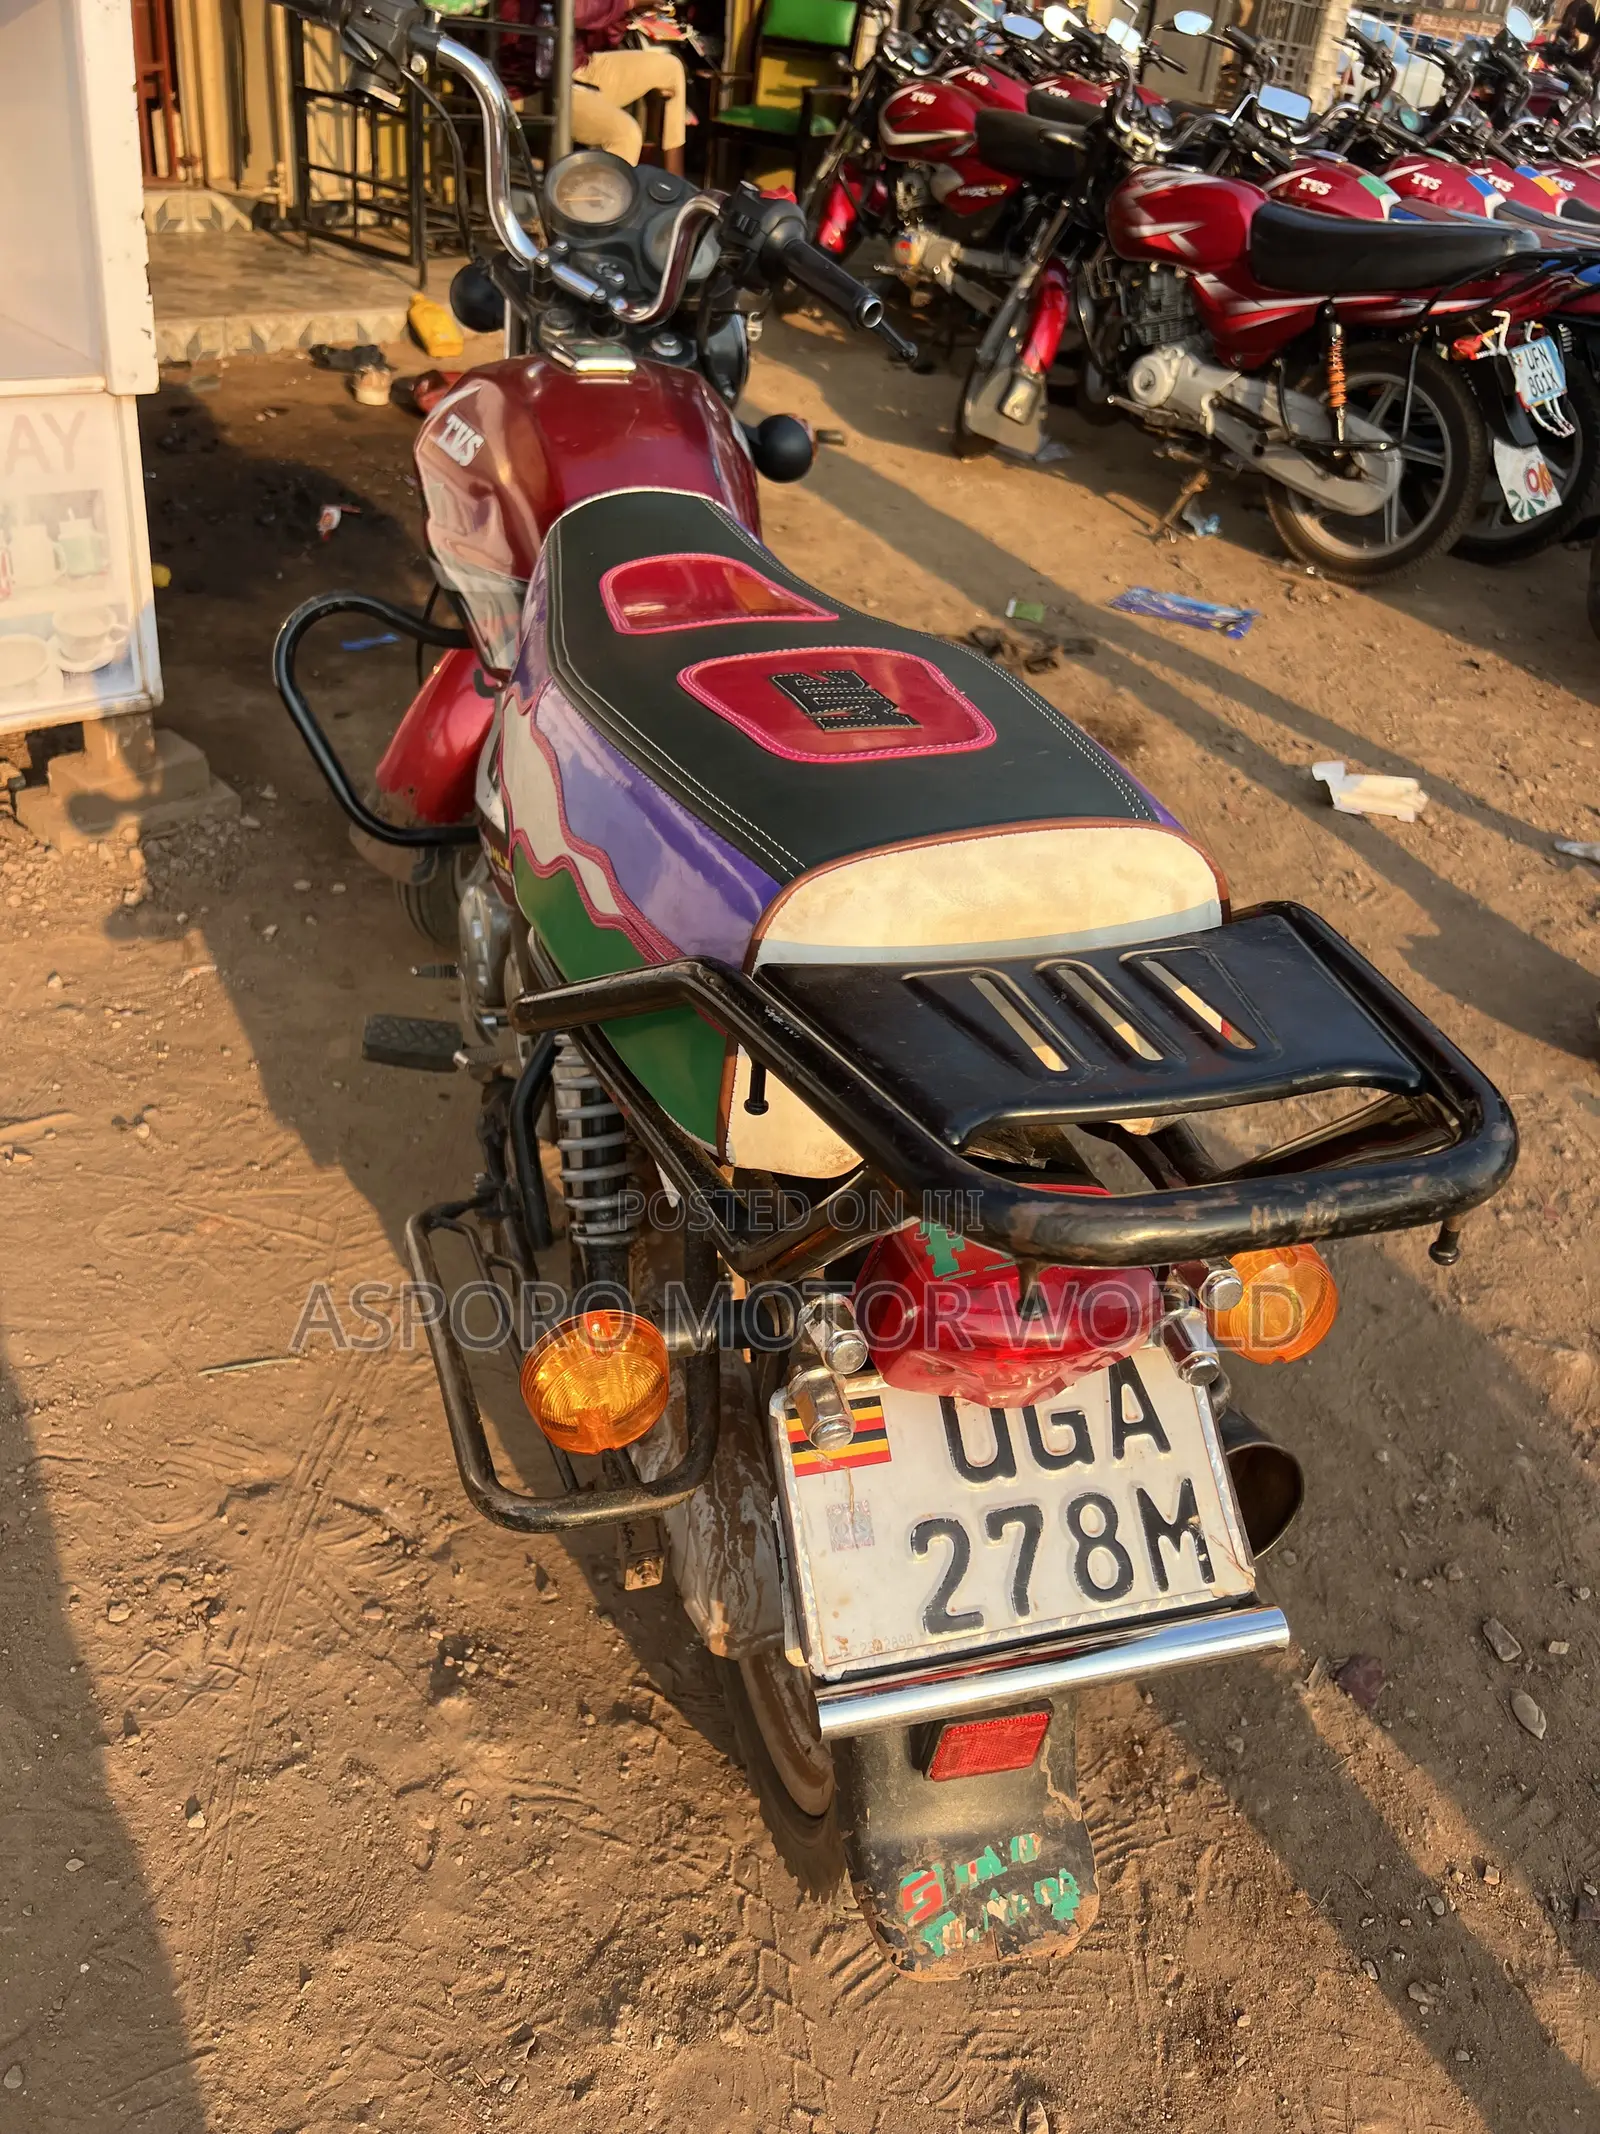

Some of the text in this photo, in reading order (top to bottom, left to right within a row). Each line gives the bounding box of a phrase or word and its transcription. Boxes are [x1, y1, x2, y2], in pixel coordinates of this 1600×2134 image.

[1524, 343, 1550, 371] UFN
[1527, 368, 1560, 398] 801X
[436, 413, 485, 467] TVS
[938, 1356, 1172, 1485] UGA
[909, 1477, 1216, 1635] 278M
